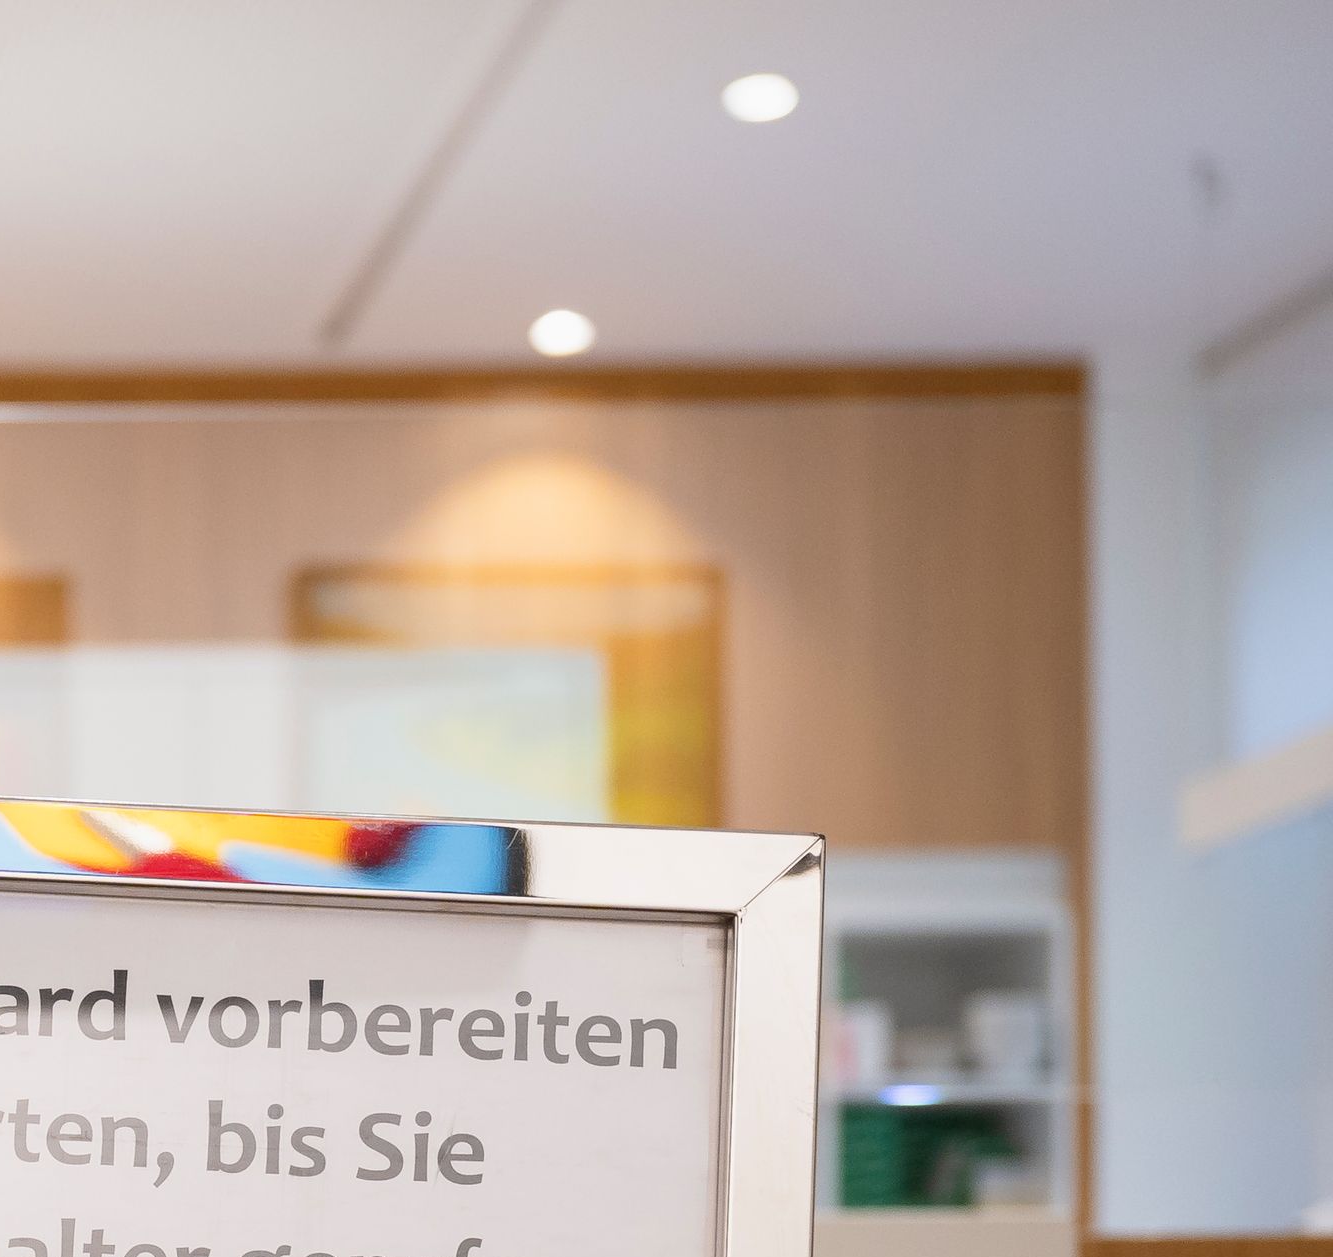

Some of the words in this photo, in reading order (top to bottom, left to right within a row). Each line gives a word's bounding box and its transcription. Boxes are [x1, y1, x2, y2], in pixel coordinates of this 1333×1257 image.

[154, 977, 680, 1071] vorbereiten
[204, 1098, 329, 1182] bis
[354, 1109, 486, 1187] Sie
